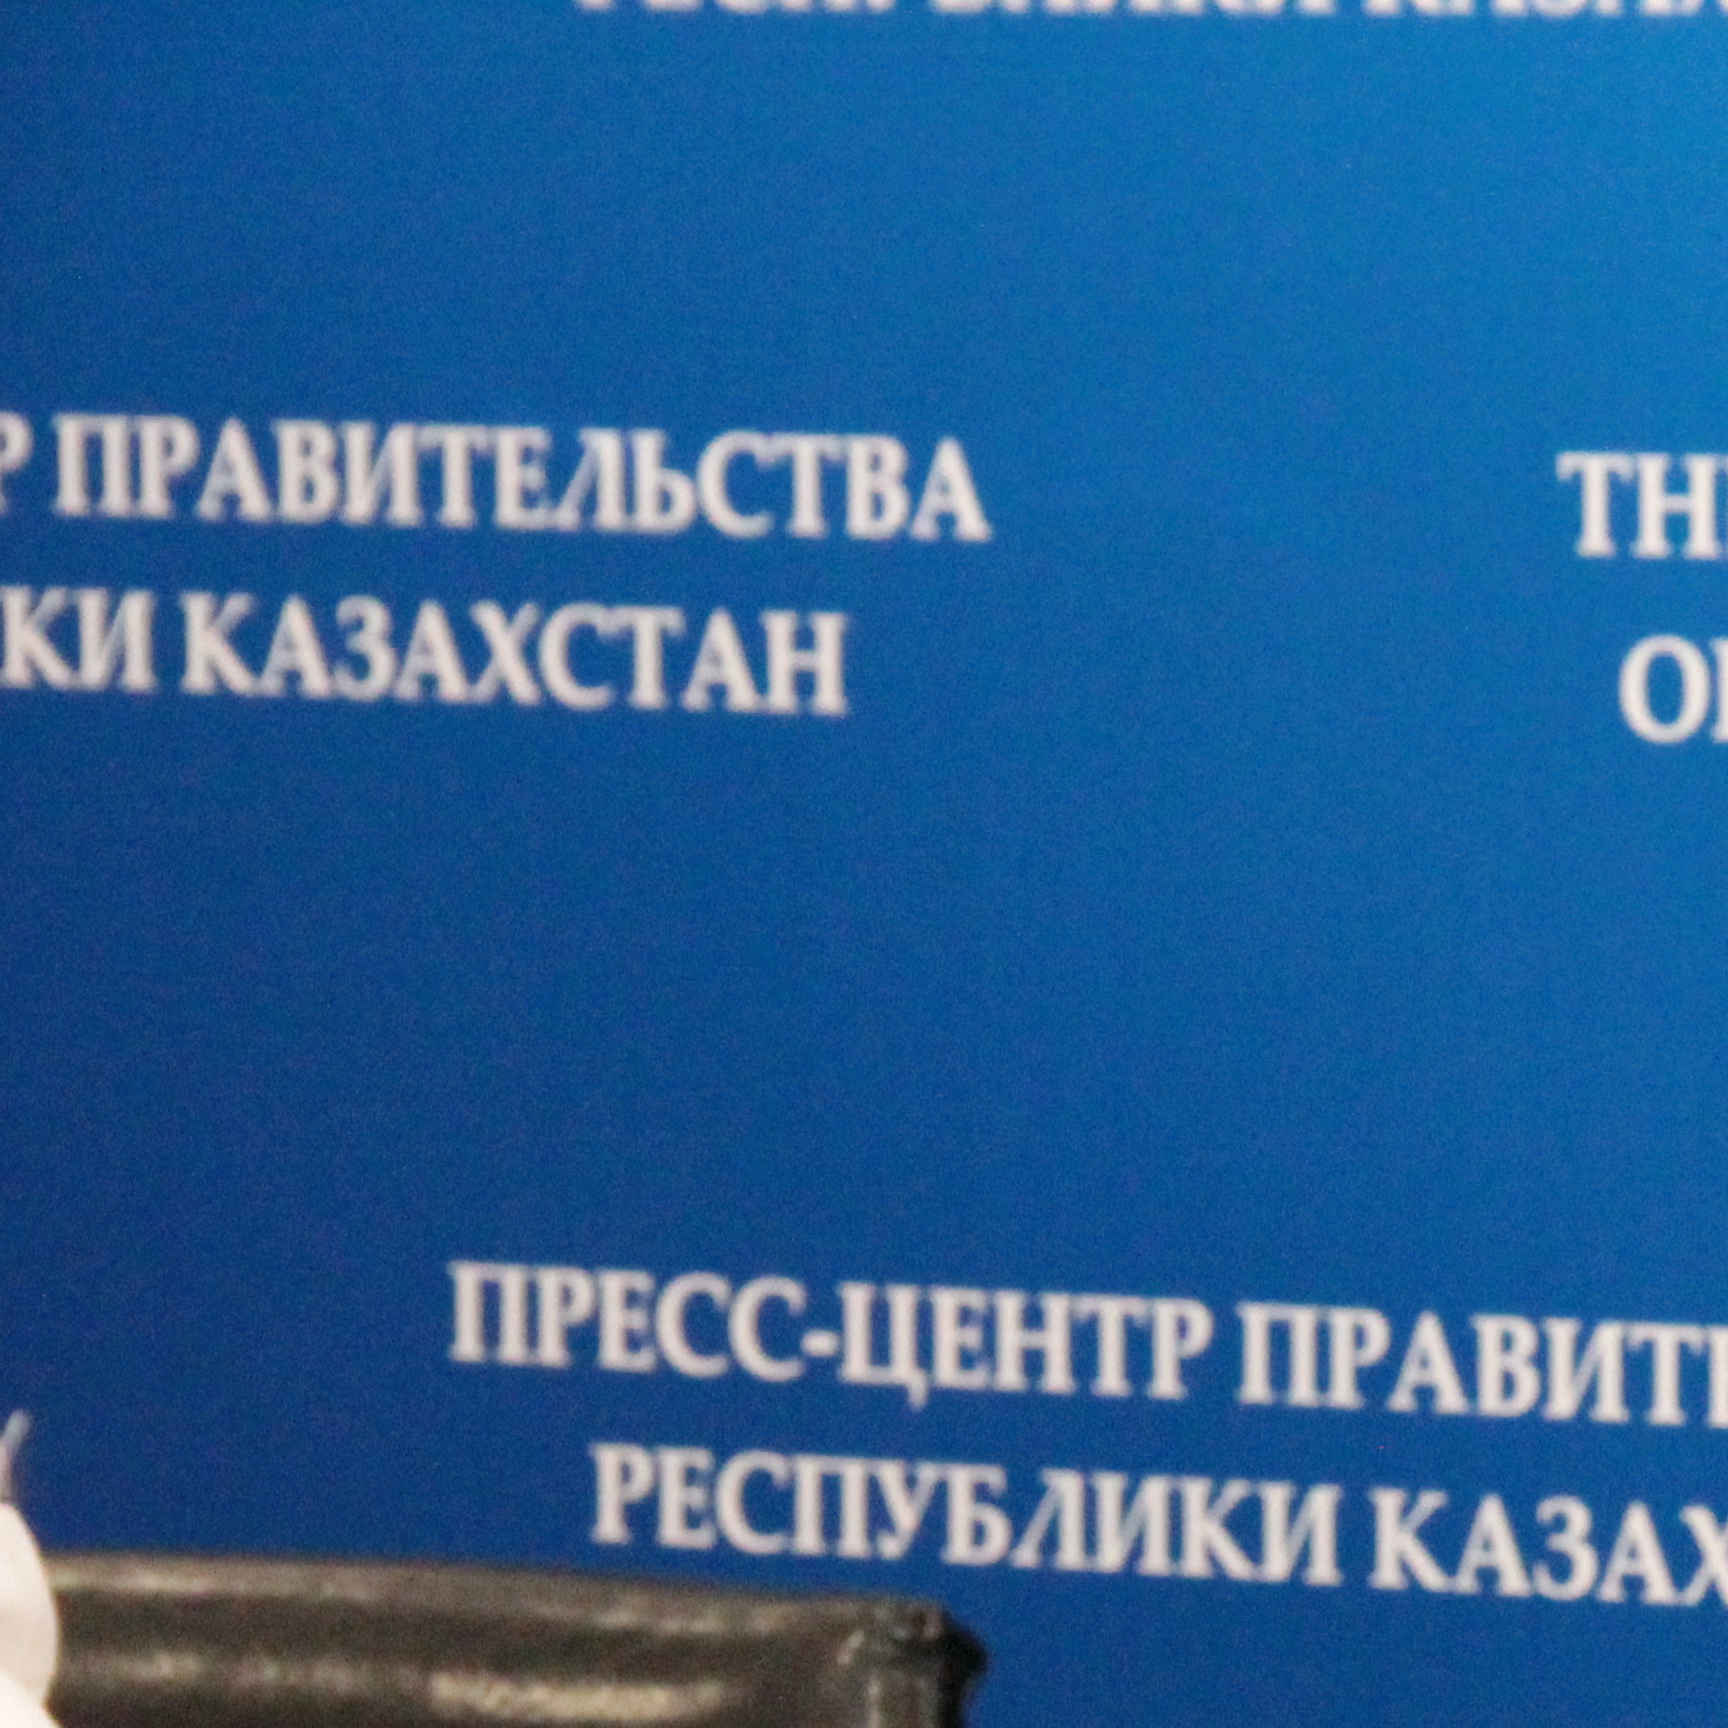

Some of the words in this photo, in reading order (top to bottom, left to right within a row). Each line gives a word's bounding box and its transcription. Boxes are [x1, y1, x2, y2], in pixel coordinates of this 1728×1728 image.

[54, 412, 992, 543] ПРАВИТЕЛЬСТВА
[180, 591, 849, 717] КАЗАХСТАН
[449, 1260, 1215, 1409] ПРЕСС-ЦЕНТР
[591, 1442, 1342, 1587] РЕСПУБЛИКИ
